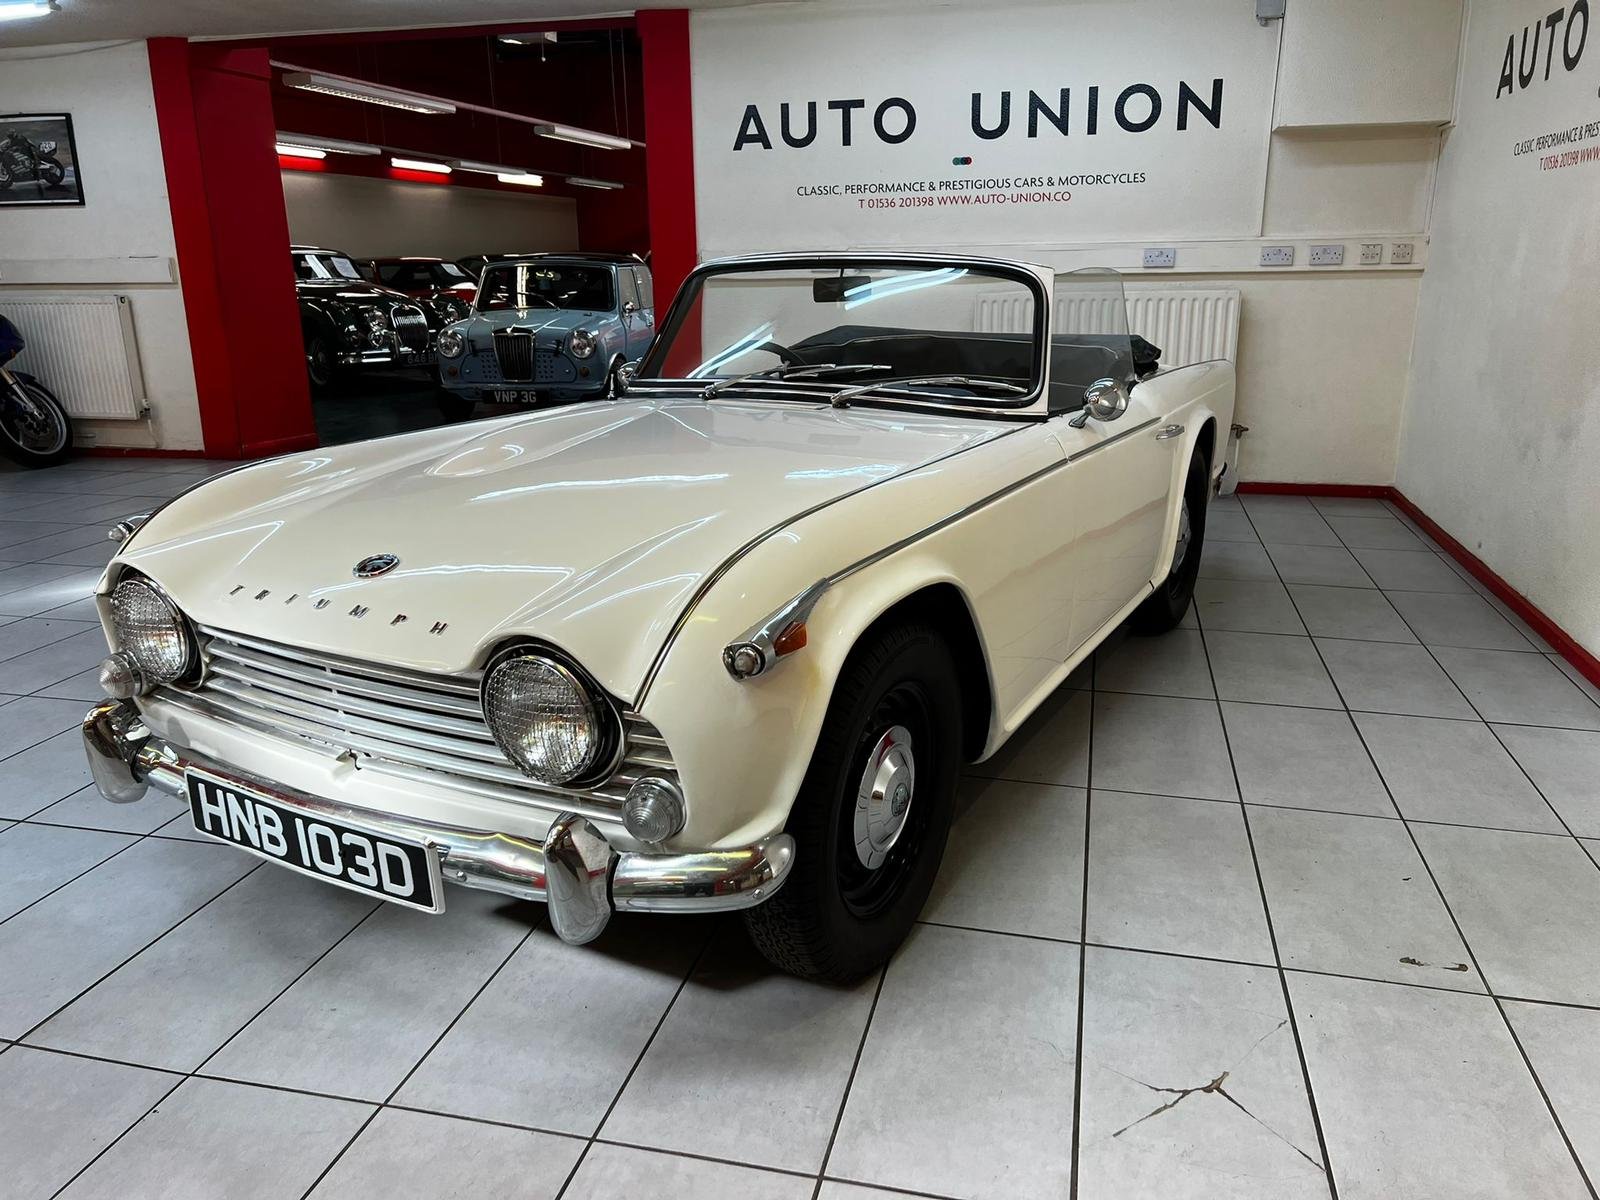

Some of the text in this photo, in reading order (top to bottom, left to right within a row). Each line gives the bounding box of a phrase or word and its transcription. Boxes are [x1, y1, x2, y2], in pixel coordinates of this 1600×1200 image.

[1495, 0, 1589, 99] AUTO
[733, 78, 1224, 151] AUTO UNION
[1536, 126, 1578, 151] PERFORMANCE
[797, 172, 1146, 197] CLASSIC, PERFORMANCE & PRESTIGIOUS CARS & MOTORCYCLES
[858, 191, 1072, 209] T 01536 201398 WWW.AUTO-UNION.CO
[494, 390, 537, 403] VNP 3G
[229, 584, 449, 636] TRIUMPH
[197, 782, 414, 897] HNB 103D
